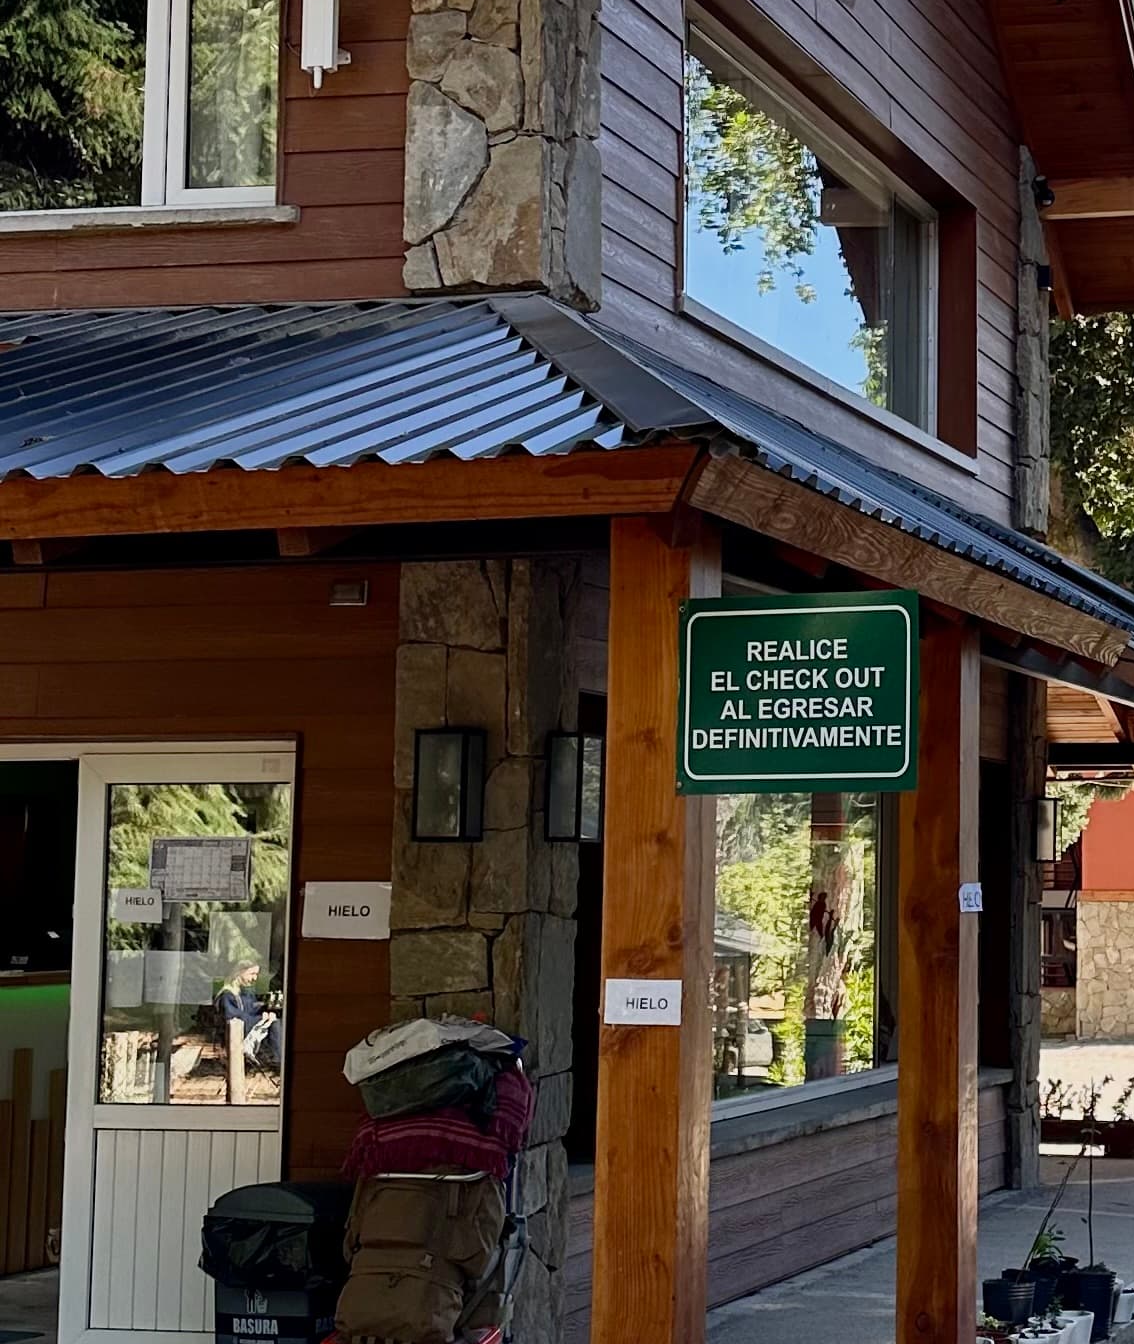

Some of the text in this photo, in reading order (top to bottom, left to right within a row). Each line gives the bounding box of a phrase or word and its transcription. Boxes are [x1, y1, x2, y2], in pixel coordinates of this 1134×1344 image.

[747, 639, 848, 661] REALICE
[711, 667, 885, 692] EL CHECK OUT
[720, 696, 873, 720] AL EGRESAR
[692, 725, 901, 750] DEFINITIVAMENTE
[125, 896, 154, 906] HIELO
[328, 904, 371, 917] HIELO
[625, 997, 668, 1010] HIELO
[233, 1318, 278, 1335] BASURA
[316, 1316, 334, 1334] BAS
